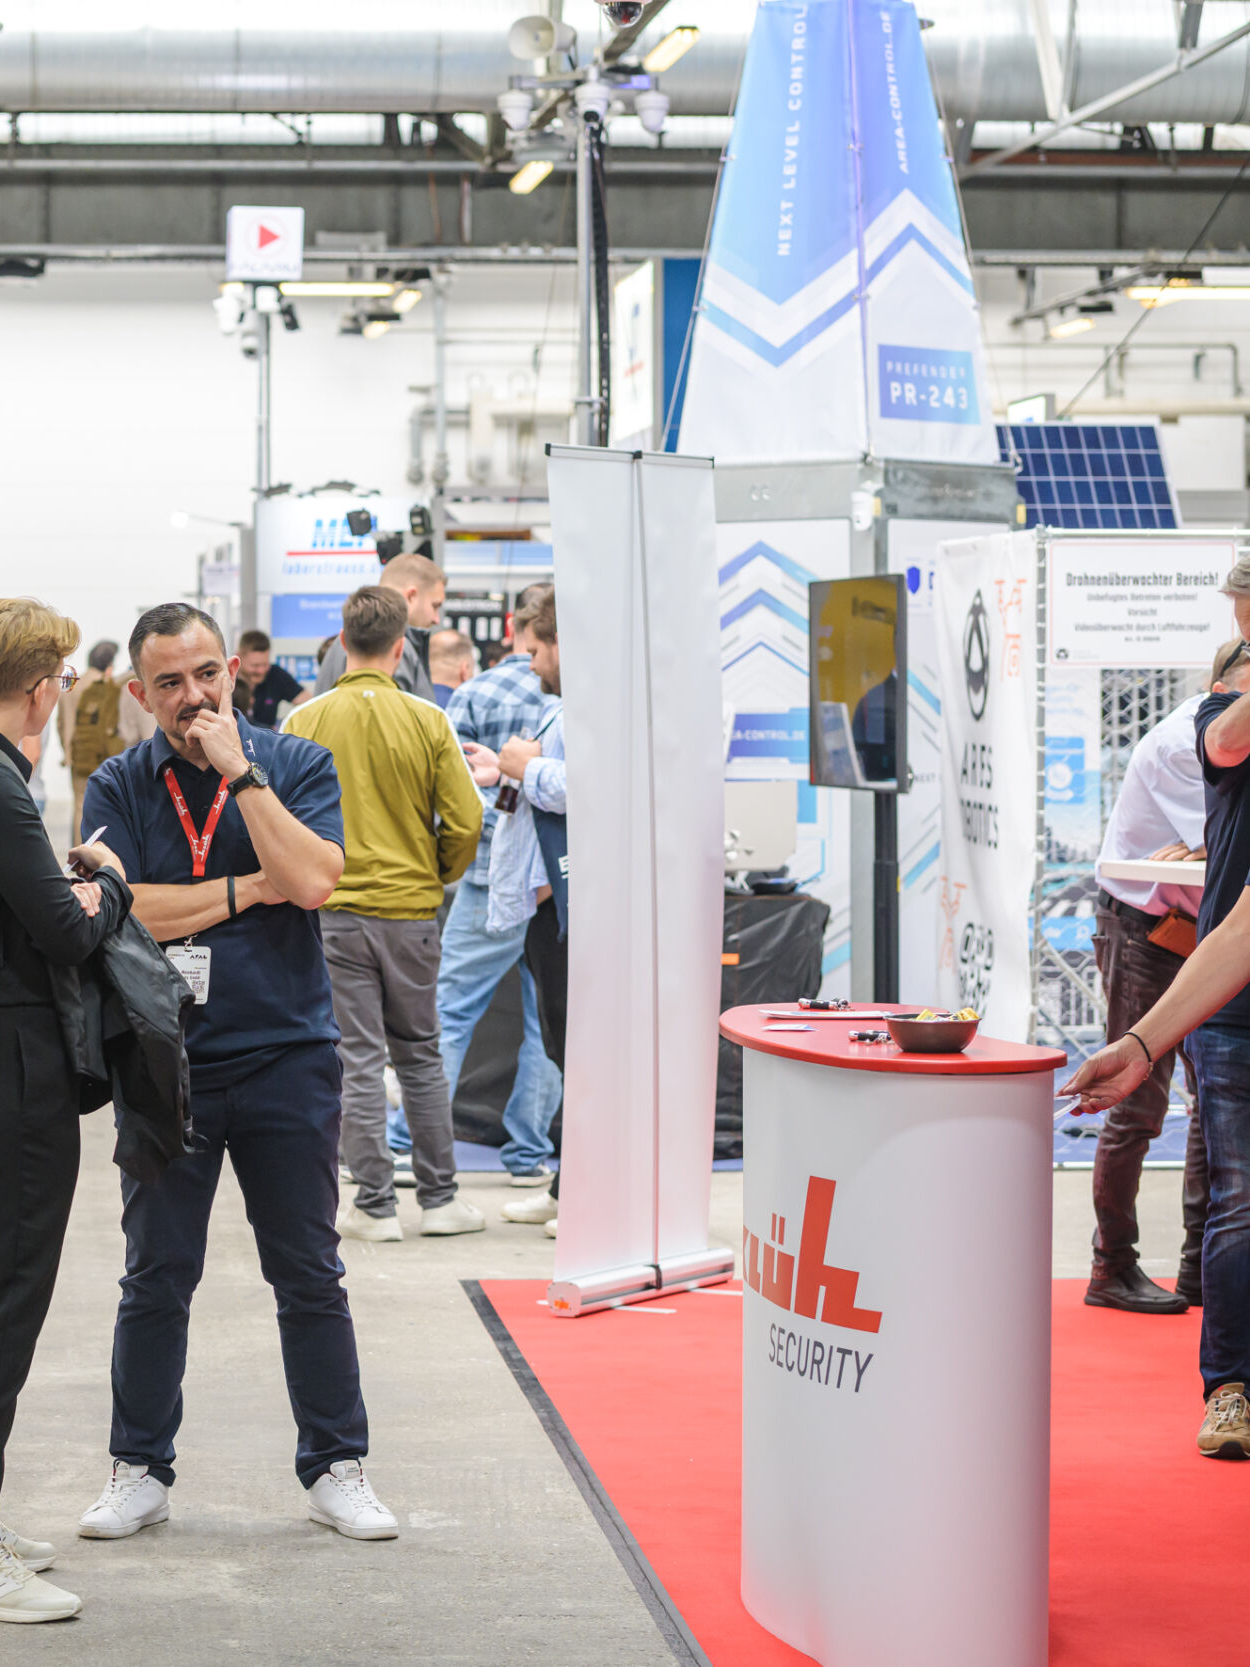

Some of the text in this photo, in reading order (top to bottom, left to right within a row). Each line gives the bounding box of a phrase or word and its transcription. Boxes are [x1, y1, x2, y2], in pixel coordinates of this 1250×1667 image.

[880, 10, 909, 174] AREA-CONTROL.DE
[777, 4, 808, 256] NEXT LEVEL CONTROL
[890, 381, 969, 410] PR-243
[1066, 571, 1219, 587] Drohnenüberwachter Bereich!
[768, 1322, 874, 1393] SECURITY
